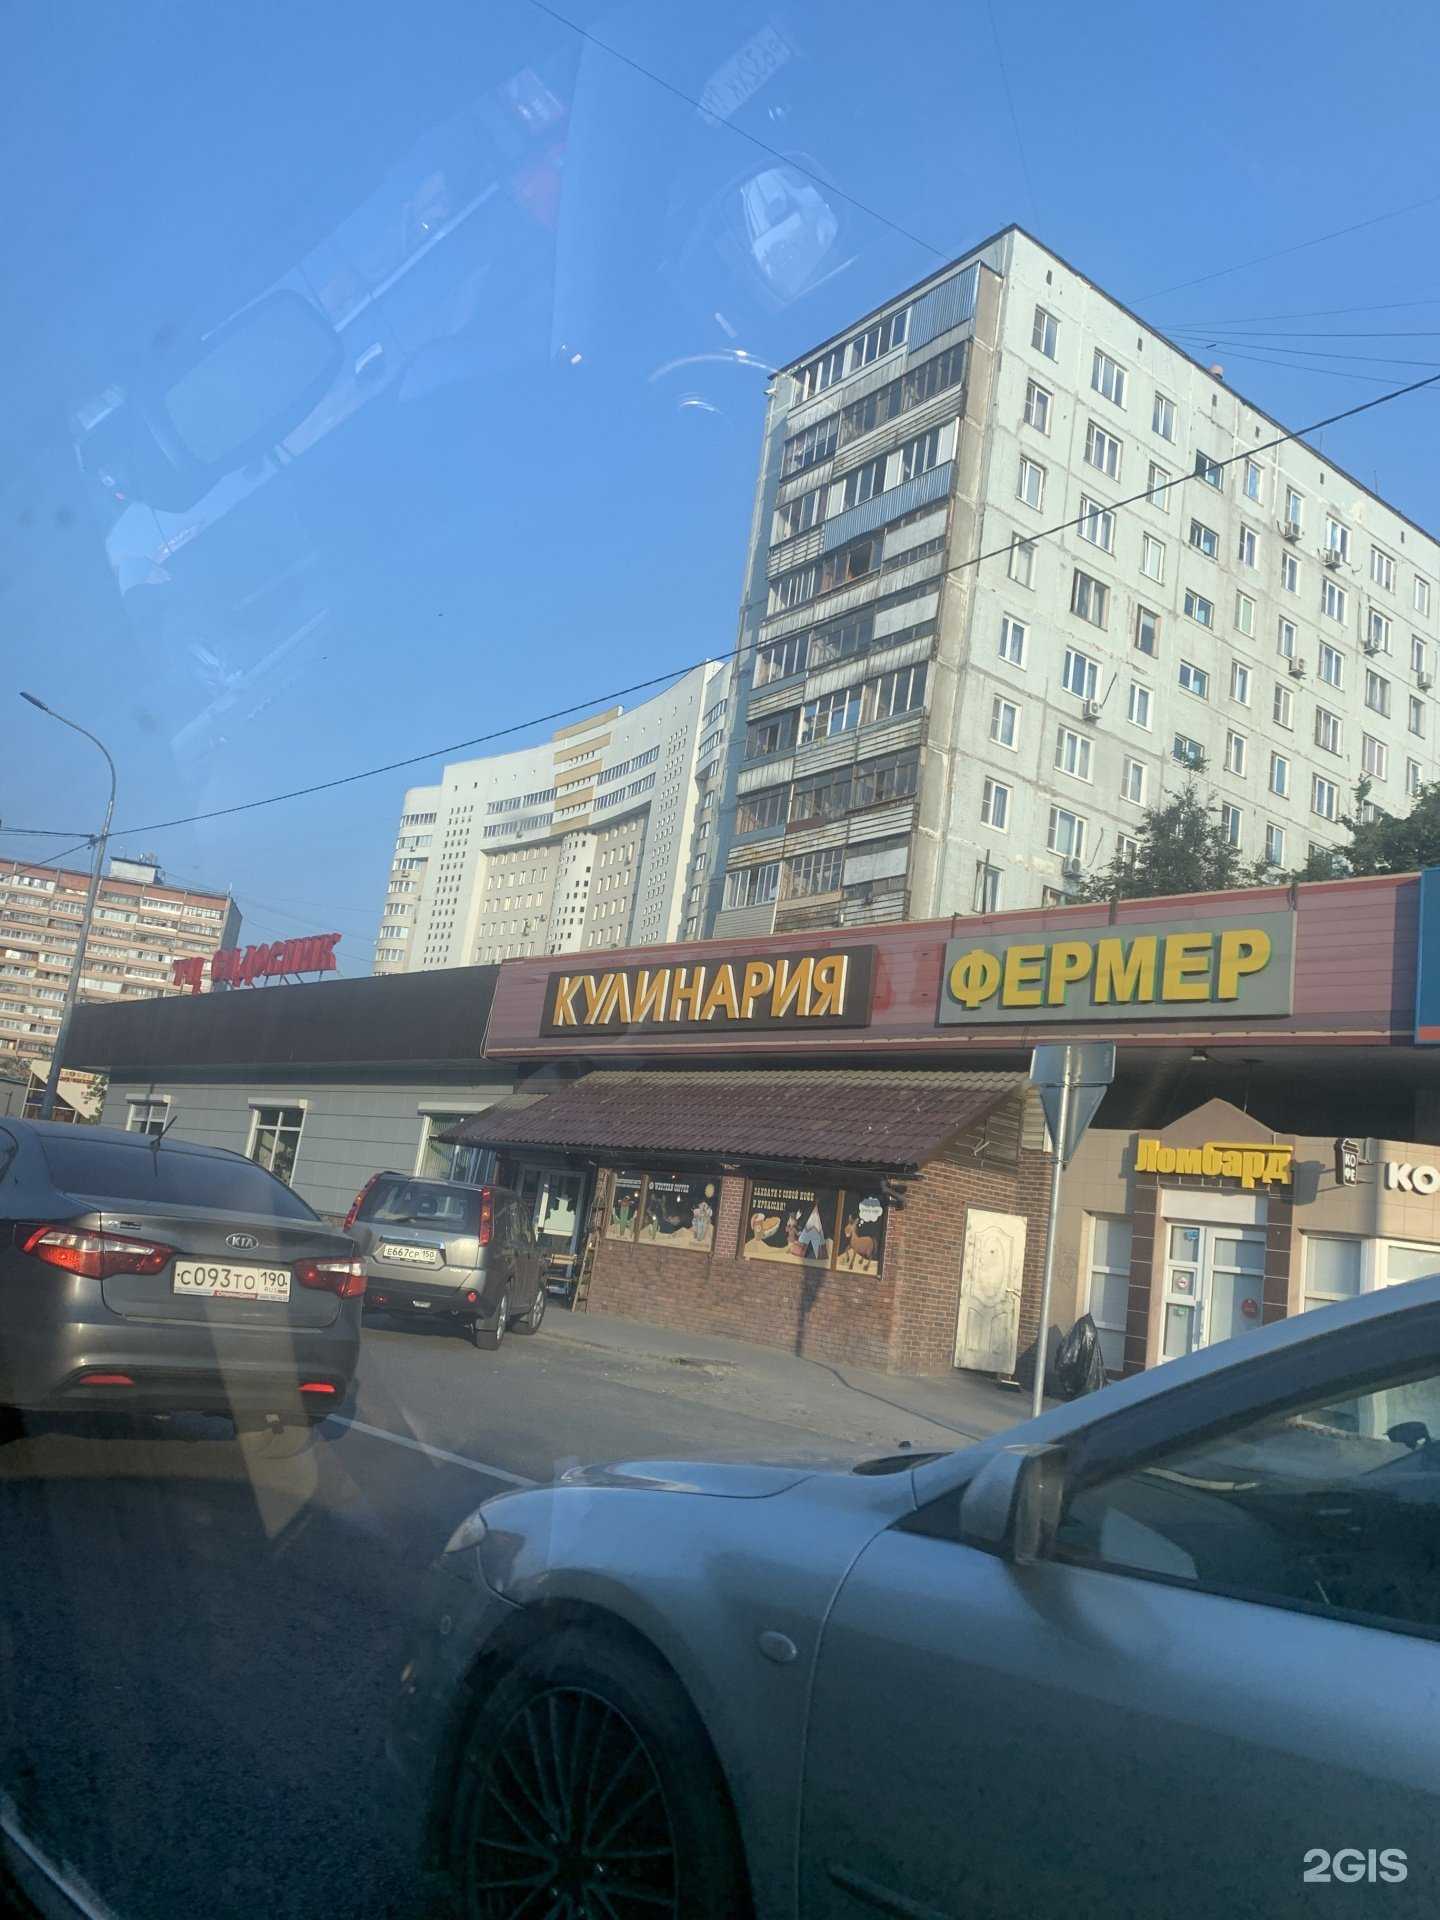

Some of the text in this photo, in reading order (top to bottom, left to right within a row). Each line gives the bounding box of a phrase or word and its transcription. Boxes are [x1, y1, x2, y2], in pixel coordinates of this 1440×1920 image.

[552, 954, 849, 1026] КУЛИНАРИЯ
[950, 929, 1272, 1008] ФЕРМЕР
[1135, 1138, 1293, 1189] Ломбард
[231, 1236, 254, 1248] KIA
[180, 1266, 286, 1290] С093ТО 190
